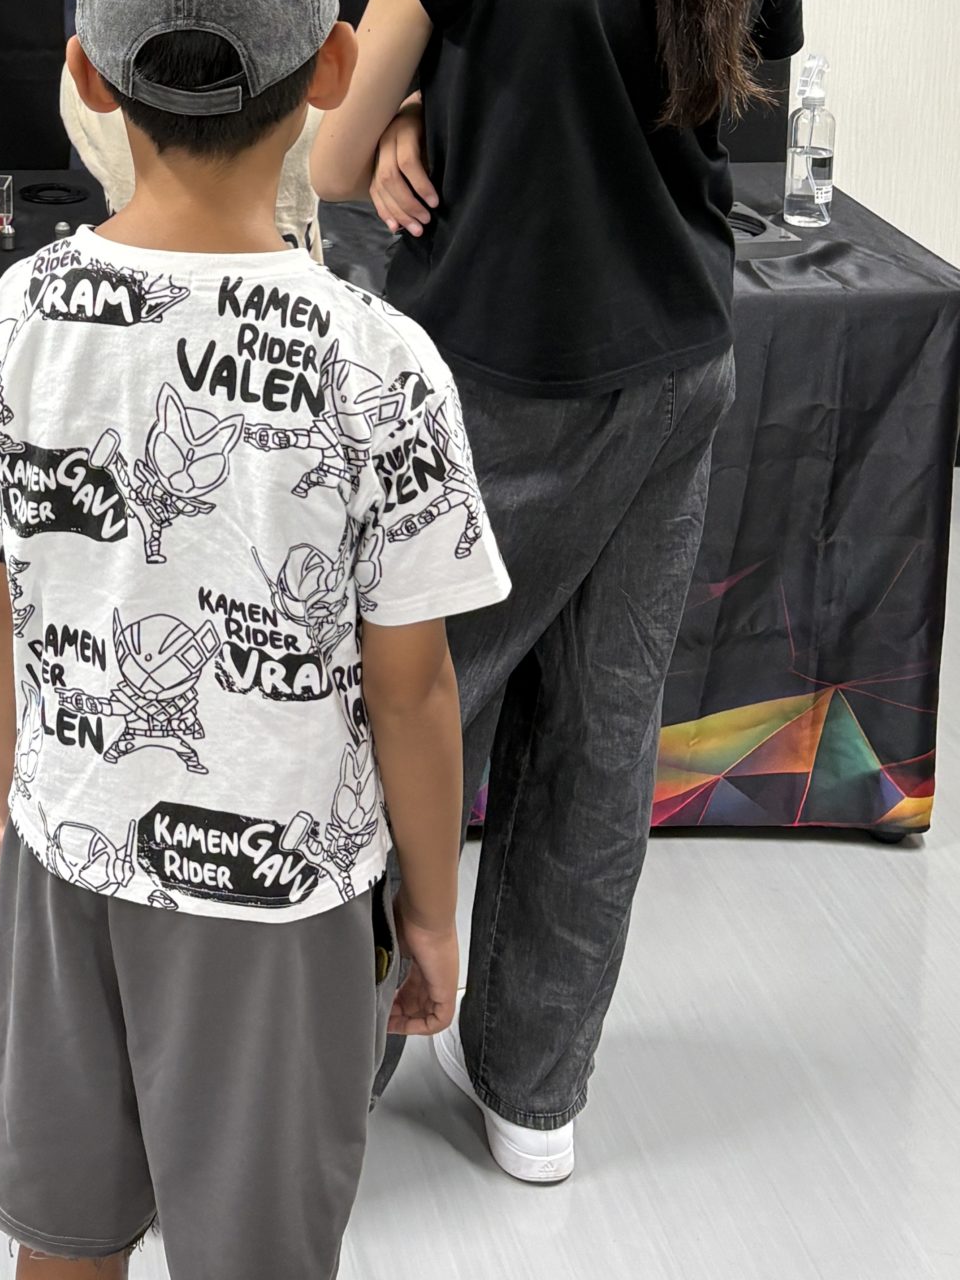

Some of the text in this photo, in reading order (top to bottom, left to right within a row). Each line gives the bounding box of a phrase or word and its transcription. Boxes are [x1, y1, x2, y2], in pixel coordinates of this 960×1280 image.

[32, 249, 82, 276] RIDER
[218, 276, 331, 338] KAMEN
[237, 323, 319, 374] RIDER
[177, 337, 326, 418] VALEN
[56, 450, 125, 539] GAVV
[198, 586, 279, 628] KAMEN
[44, 623, 107, 672] AMEN
[224, 617, 302, 653] RIDER
[41, 696, 104, 755] LEN
[154, 813, 316, 902] KAMEN GAVV
[164, 849, 234, 890] RIDER
